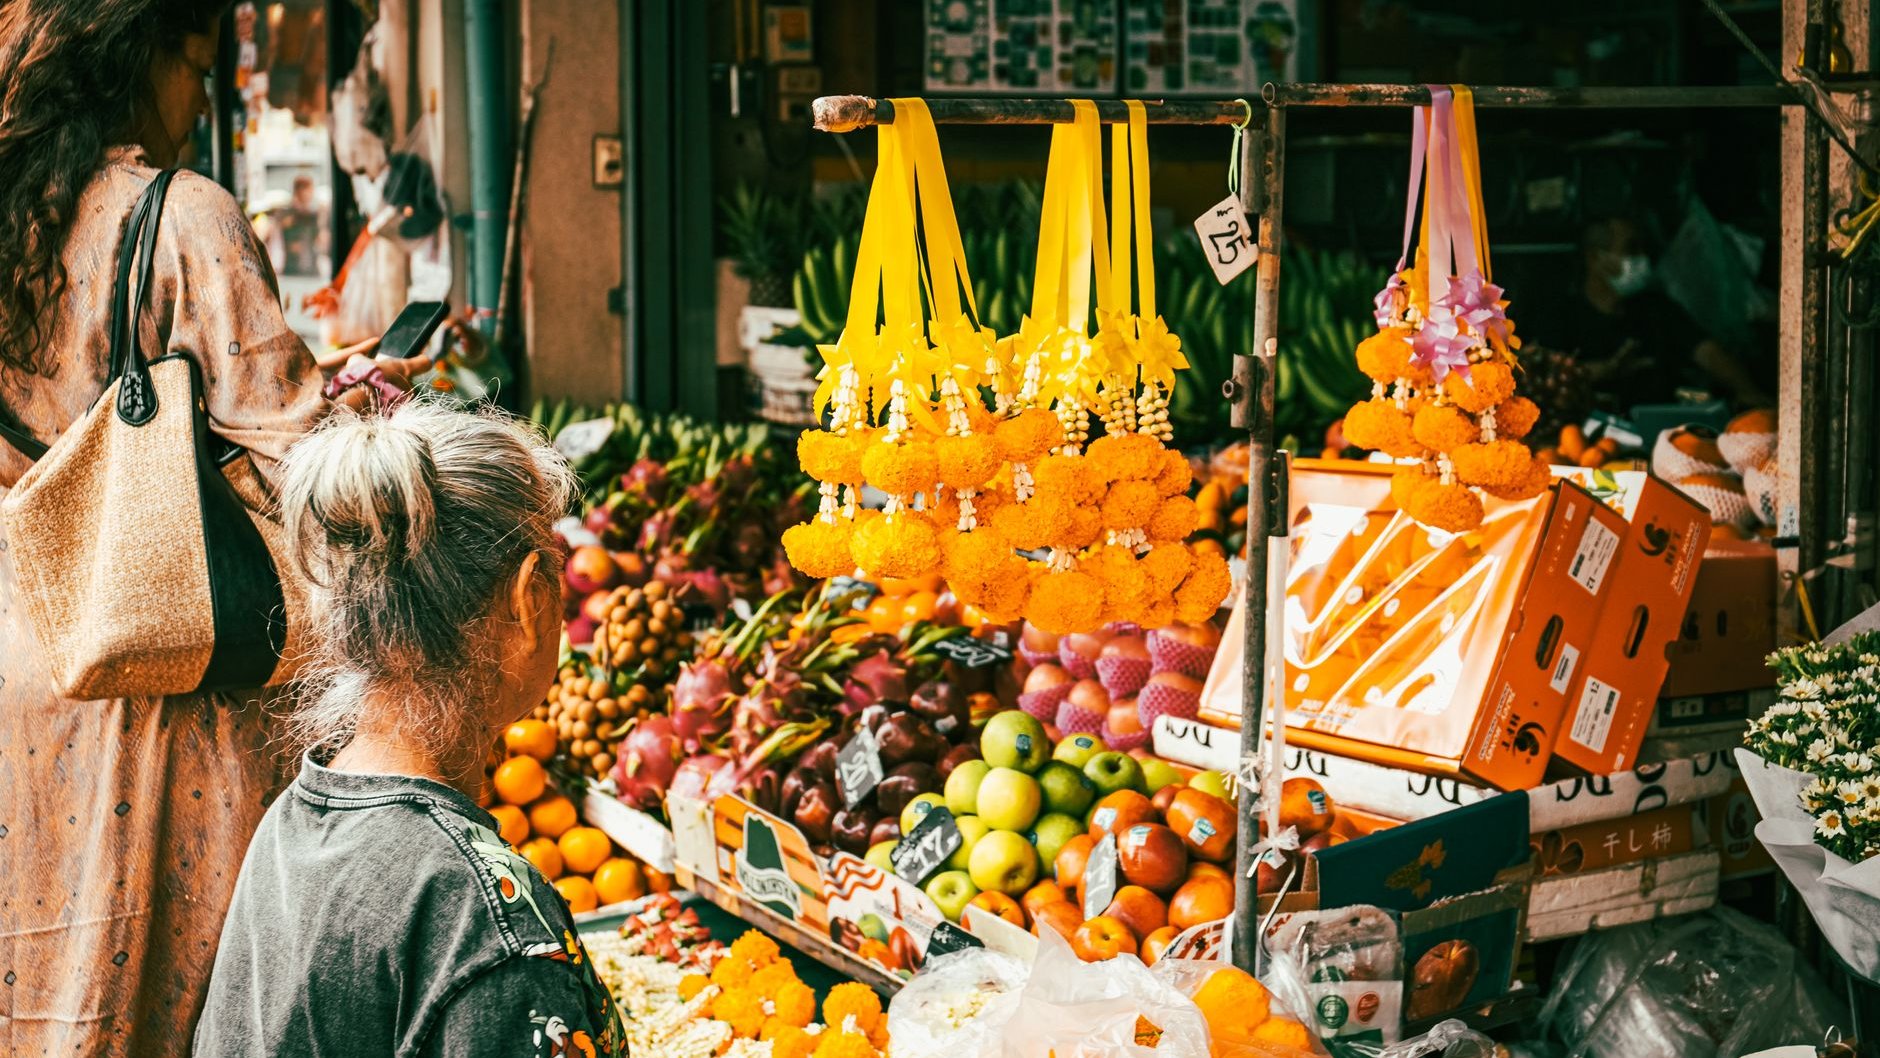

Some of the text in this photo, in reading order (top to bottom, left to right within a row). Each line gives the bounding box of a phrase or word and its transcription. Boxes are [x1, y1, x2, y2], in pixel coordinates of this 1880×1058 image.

[1208, 220, 1247, 264] 25
[1602, 824, 1673, 859] 干し柿
